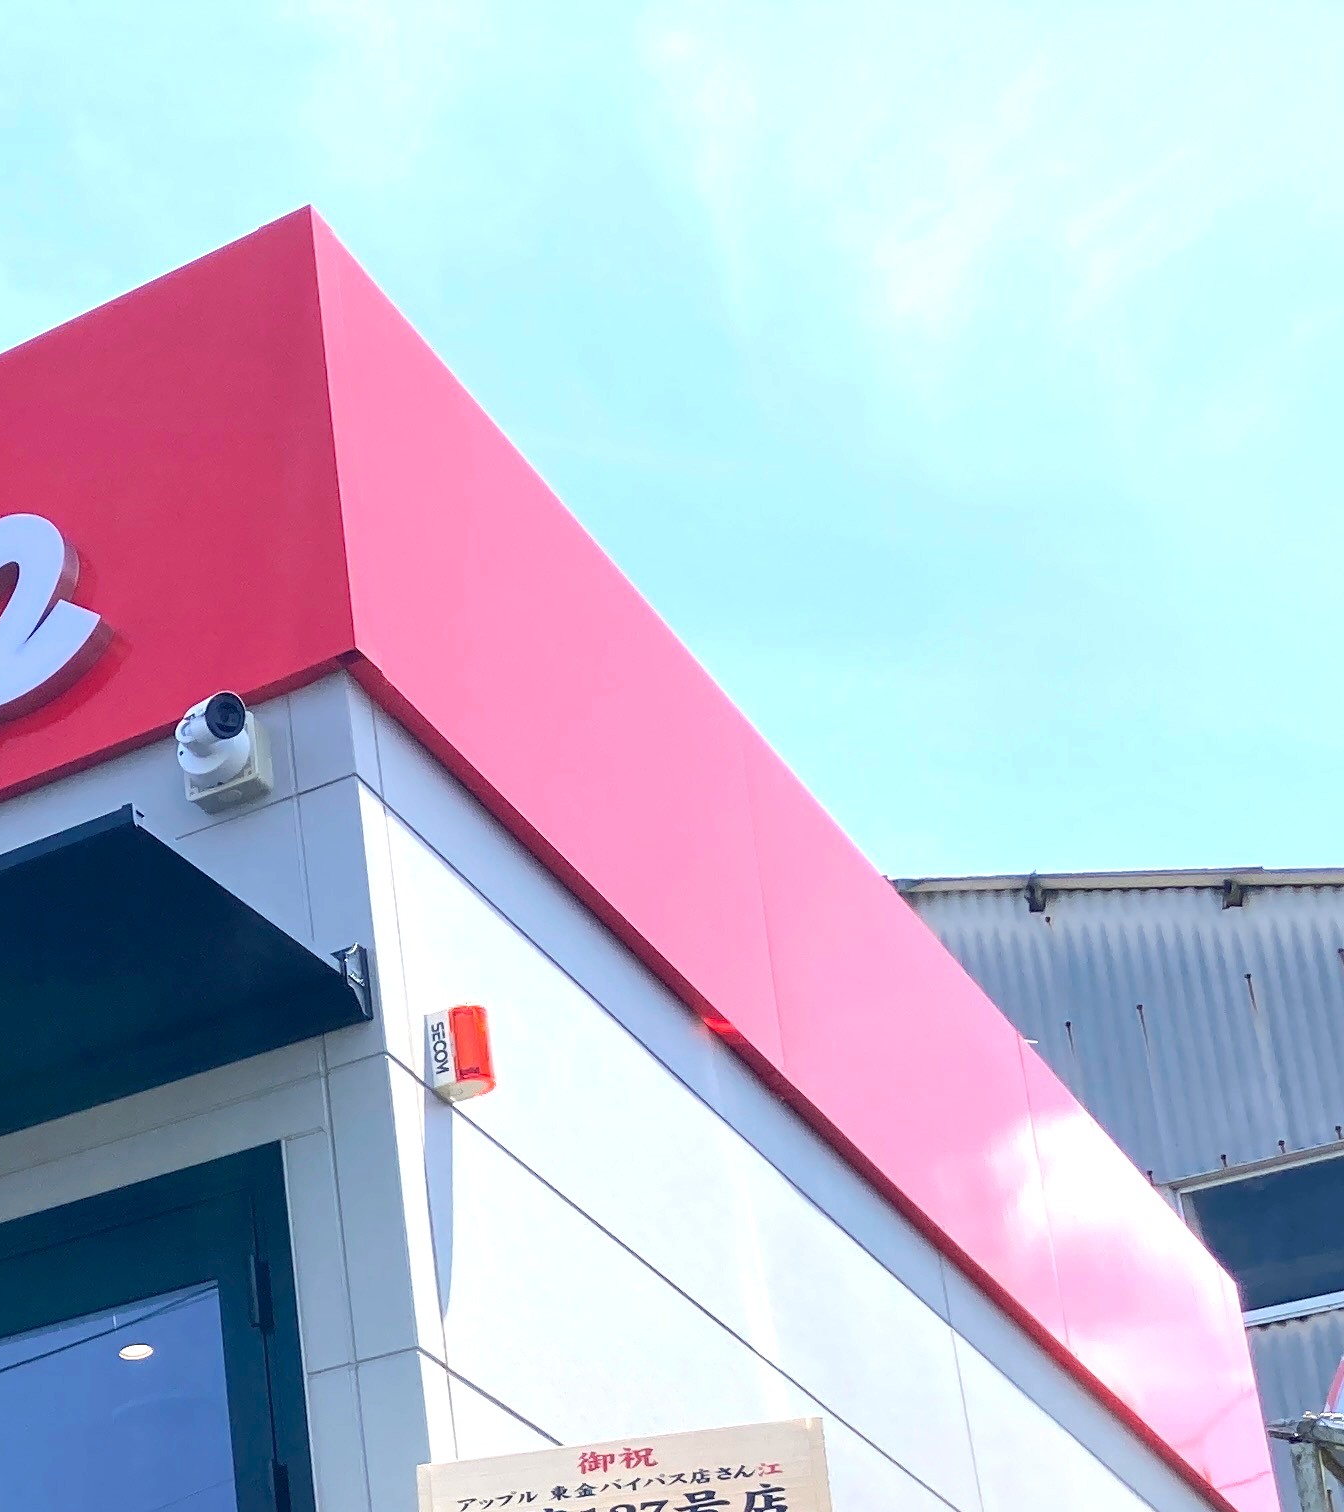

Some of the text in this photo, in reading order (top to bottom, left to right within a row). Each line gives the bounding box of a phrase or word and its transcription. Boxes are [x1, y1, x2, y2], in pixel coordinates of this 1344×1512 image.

[430, 1021, 449, 1075] SECOM
[576, 1446, 659, 1475] 御祝
[457, 1489, 538, 1512] アップル
